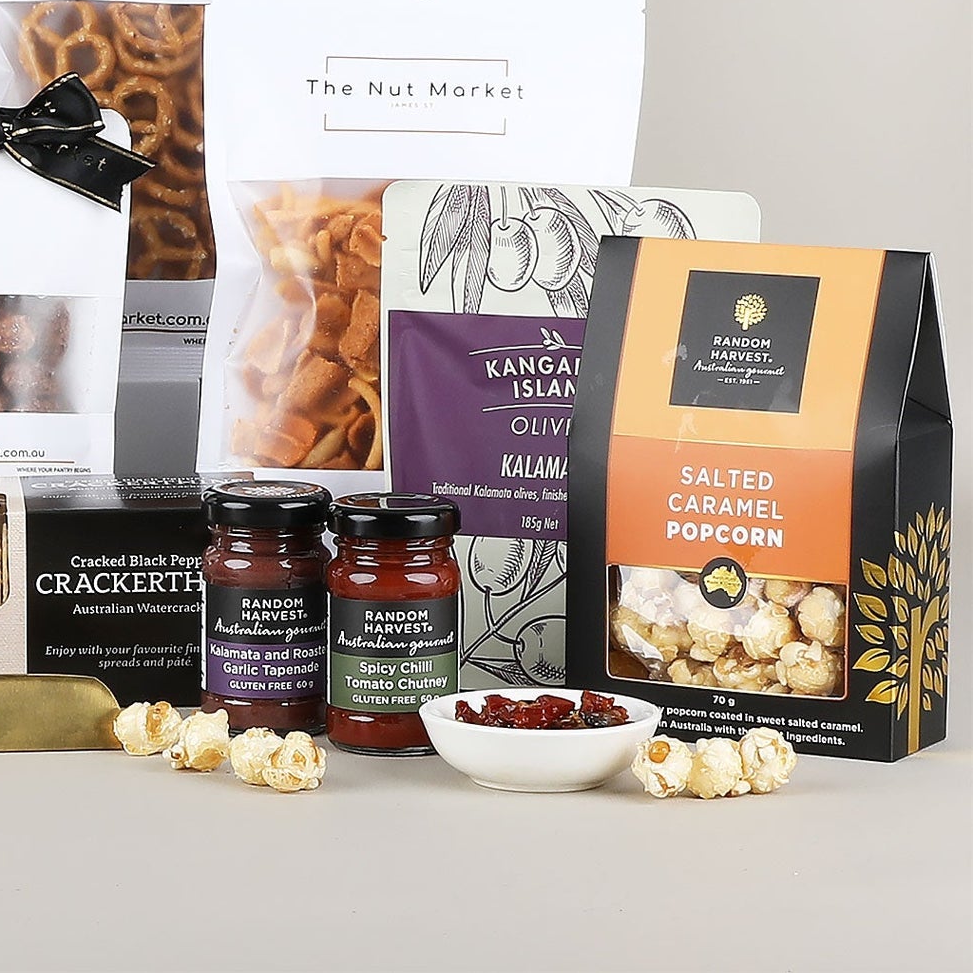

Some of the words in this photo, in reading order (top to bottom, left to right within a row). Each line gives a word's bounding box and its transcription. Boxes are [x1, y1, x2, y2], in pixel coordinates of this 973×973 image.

[306, 79, 353, 96] The
[368, 81, 414, 97] Nut
[429, 82, 525, 100] Market
[712, 335, 772, 349] RANDOM
[692, 359, 746, 373] Australian
[744, 366, 786, 379] gourmet
[679, 465, 775, 492] SALTED
[431, 481, 472, 497] Traditional
[472, 483, 513, 499] Kalamata
[513, 486, 540, 502] olives,
[667, 492, 785, 521] CARAMEL
[521, 515, 543, 532] 185g
[543, 517, 559, 531] Net
[666, 520, 785, 549] POPCORN
[70, 554, 127, 568] Cracked
[128, 554, 168, 568] Black
[35, 570, 203, 596] CRACKERTH
[72, 603, 135, 616] Australian
[136, 602, 203, 614] Watercrack
[241, 597, 304, 609] RANDOM
[364, 609, 429, 622] RANDOM
[214, 616, 285, 636] Australian
[44, 645, 77, 658] Enjoy
[77, 644, 104, 656] with
[104, 646, 131, 658] your
[131, 643, 184, 657] favourite
[183, 643, 201, 656] fin
[210, 643, 261, 661] Kalamata
[264, 648, 290, 661] and
[337, 630, 409, 649] Australian
[408, 630, 455, 657] gourmet
[97, 657, 142, 670] spreads
[142, 656, 165, 668] and
[165, 656, 194, 670] pâté.
[222, 662, 259, 676] Garlic
[262, 661, 320, 678] Tapenade
[359, 661, 397, 677] Spicy
[400, 660, 433, 675] Chilli
[229, 680, 266, 691] GLUTEN
[268, 681, 292, 691] FREE
[296, 680, 308, 689] 60
[344, 675, 394, 691] Tomato
[397, 675, 448, 691] Chutney
[352, 694, 389, 705] GLUTEN
[391, 695, 417, 705] FREE
[712, 694, 727, 706] 70
[727, 698, 736, 708] g
[666, 705, 708, 719] popcorn
[709, 710, 743, 723] coated
[744, 712, 755, 724] in
[756, 715, 787, 727] sweet
[787, 717, 819, 730] salted
[820, 721, 865, 734] caramel.
[669, 719, 713, 733] Australia
[713, 725, 736, 736] with
